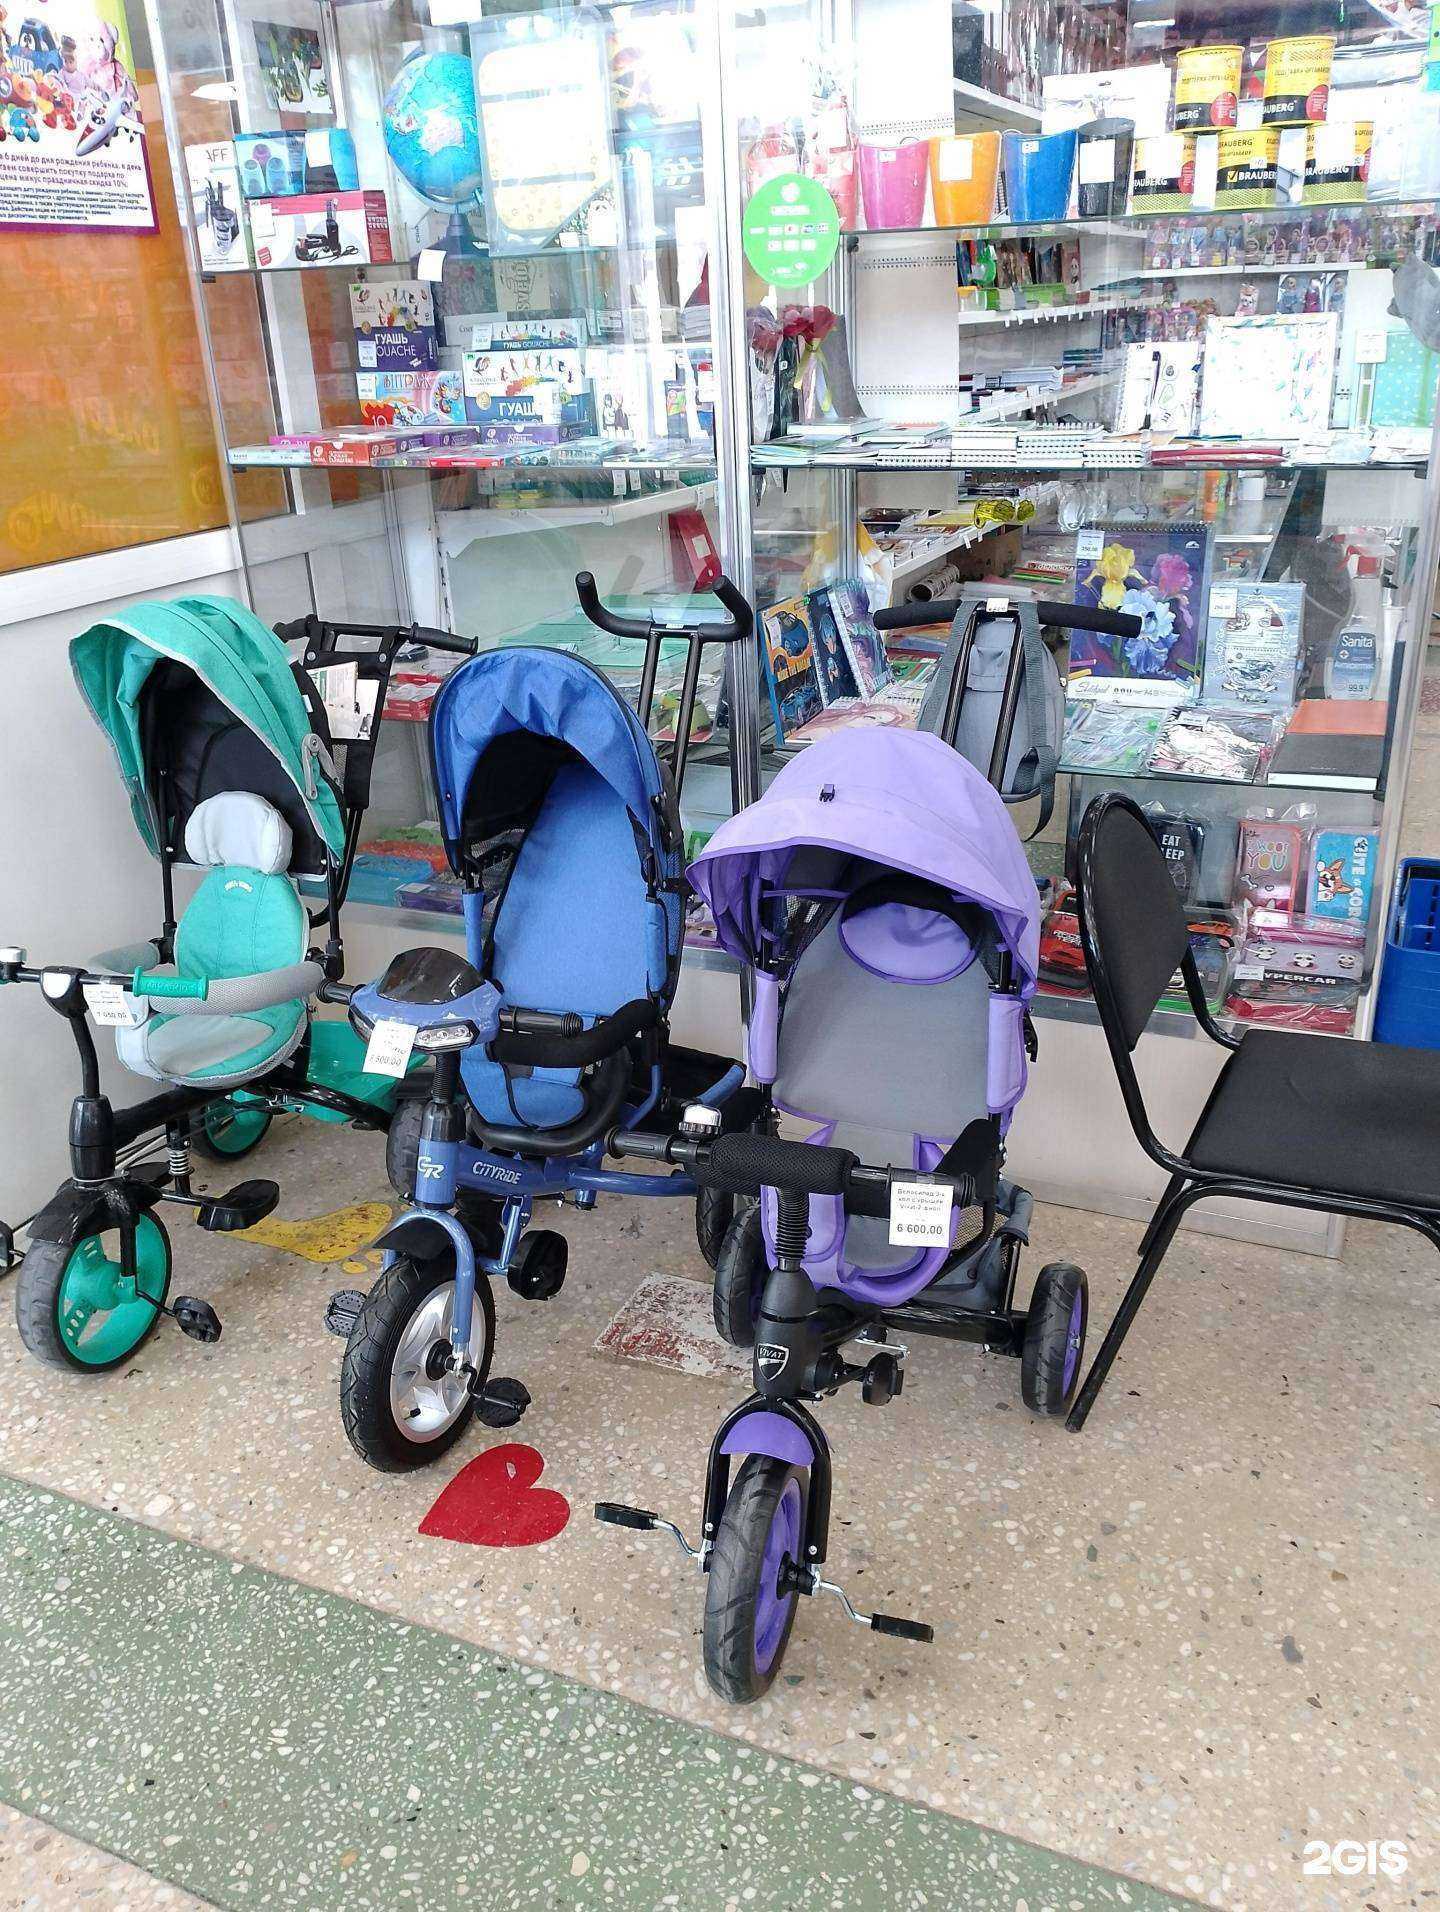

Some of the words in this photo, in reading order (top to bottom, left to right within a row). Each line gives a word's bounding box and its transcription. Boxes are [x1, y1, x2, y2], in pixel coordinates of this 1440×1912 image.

[374, 333, 409, 345] ГУАШЬ
[376, 344, 417, 357] OUACHE
[499, 401, 537, 417] ГУАШ
[1342, 635, 1373, 648] Sanita
[1161, 834, 1182, 847] EAT
[1247, 851, 1288, 872] YOU
[1264, 972, 1337, 985] YPERCAR
[896, 1223, 904, 1233] 6
[907, 1223, 943, 1235] 600,00
[760, 1347, 785, 1359] VIVAT
